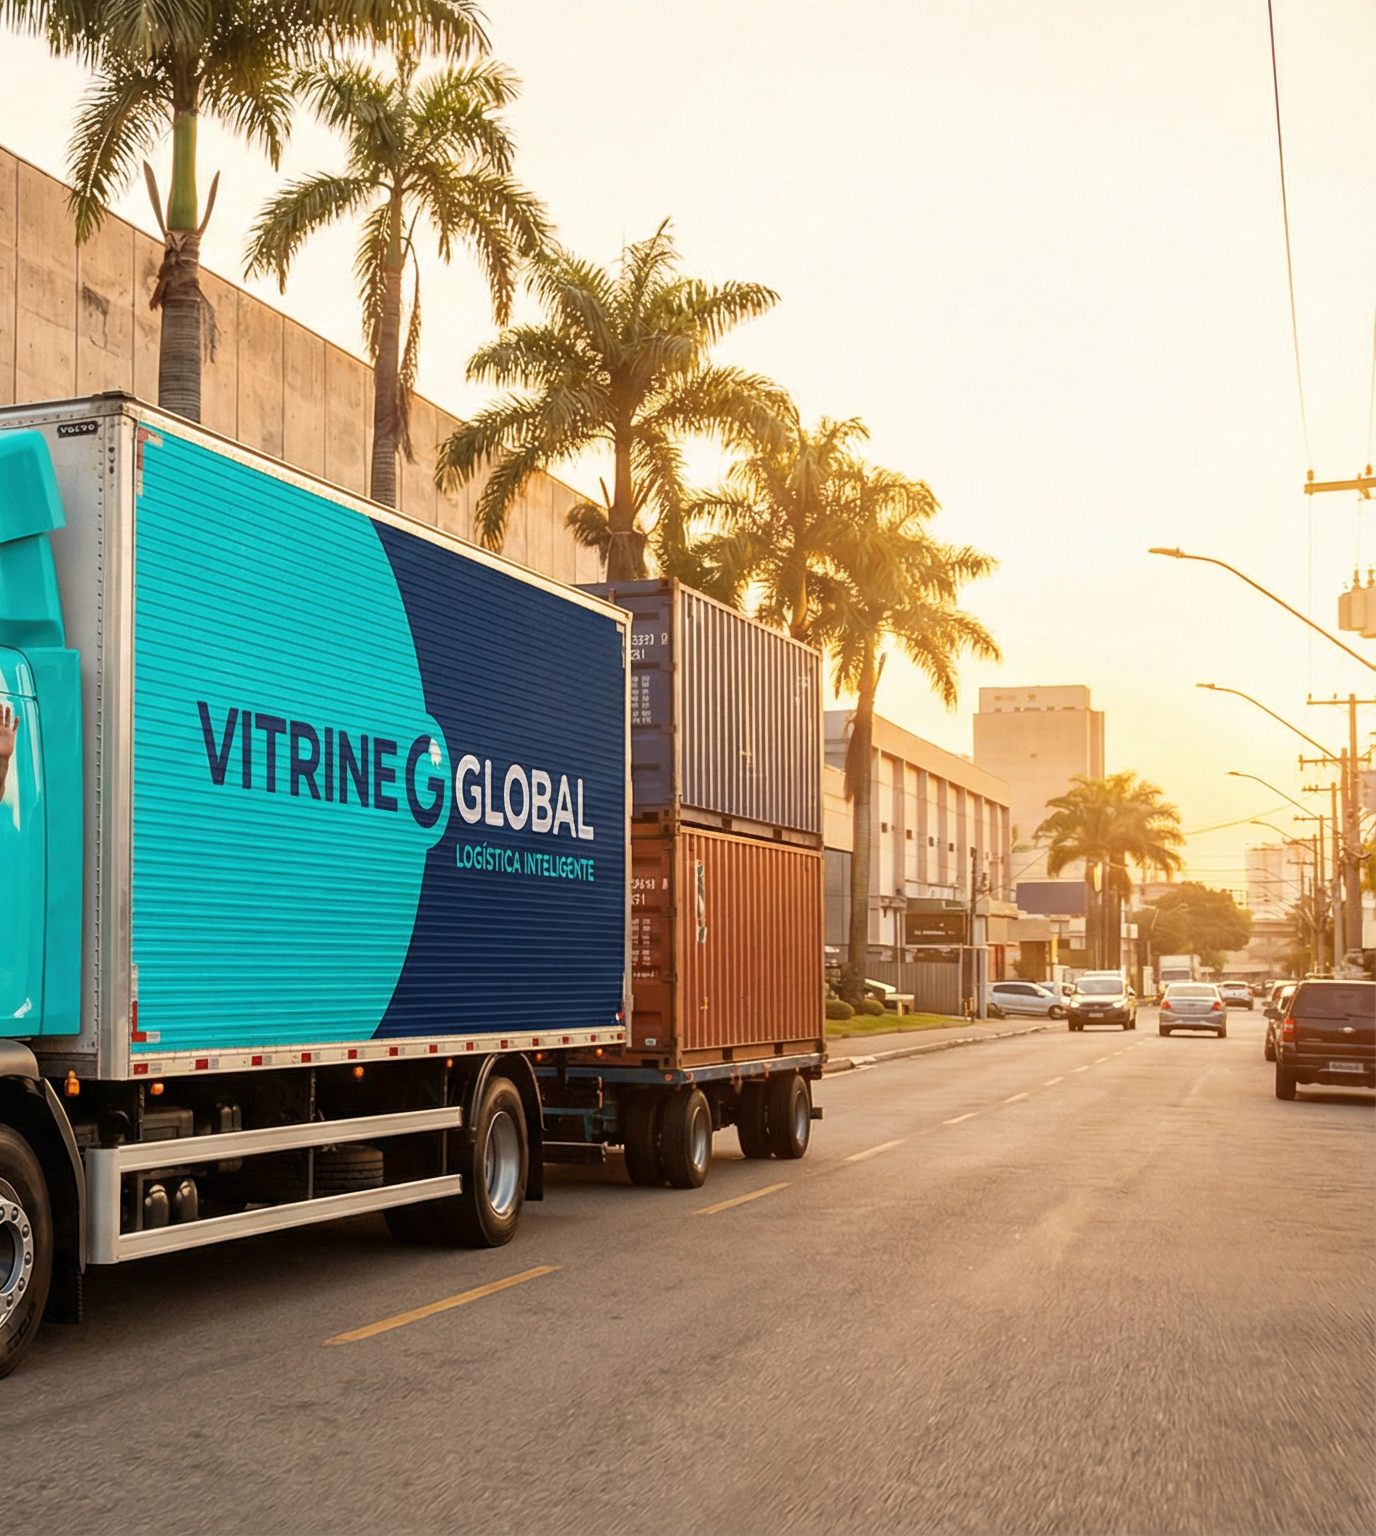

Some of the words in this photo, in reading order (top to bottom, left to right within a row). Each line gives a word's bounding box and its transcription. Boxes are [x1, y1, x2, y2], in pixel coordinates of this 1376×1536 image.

[59, 423, 95, 434] VOLVO
[196, 700, 399, 813] VITRINE
[454, 753, 595, 842] GLOBAL
[455, 841, 522, 874] LOGÍSTICA
[523, 850, 595, 882] INTELIGENTE
